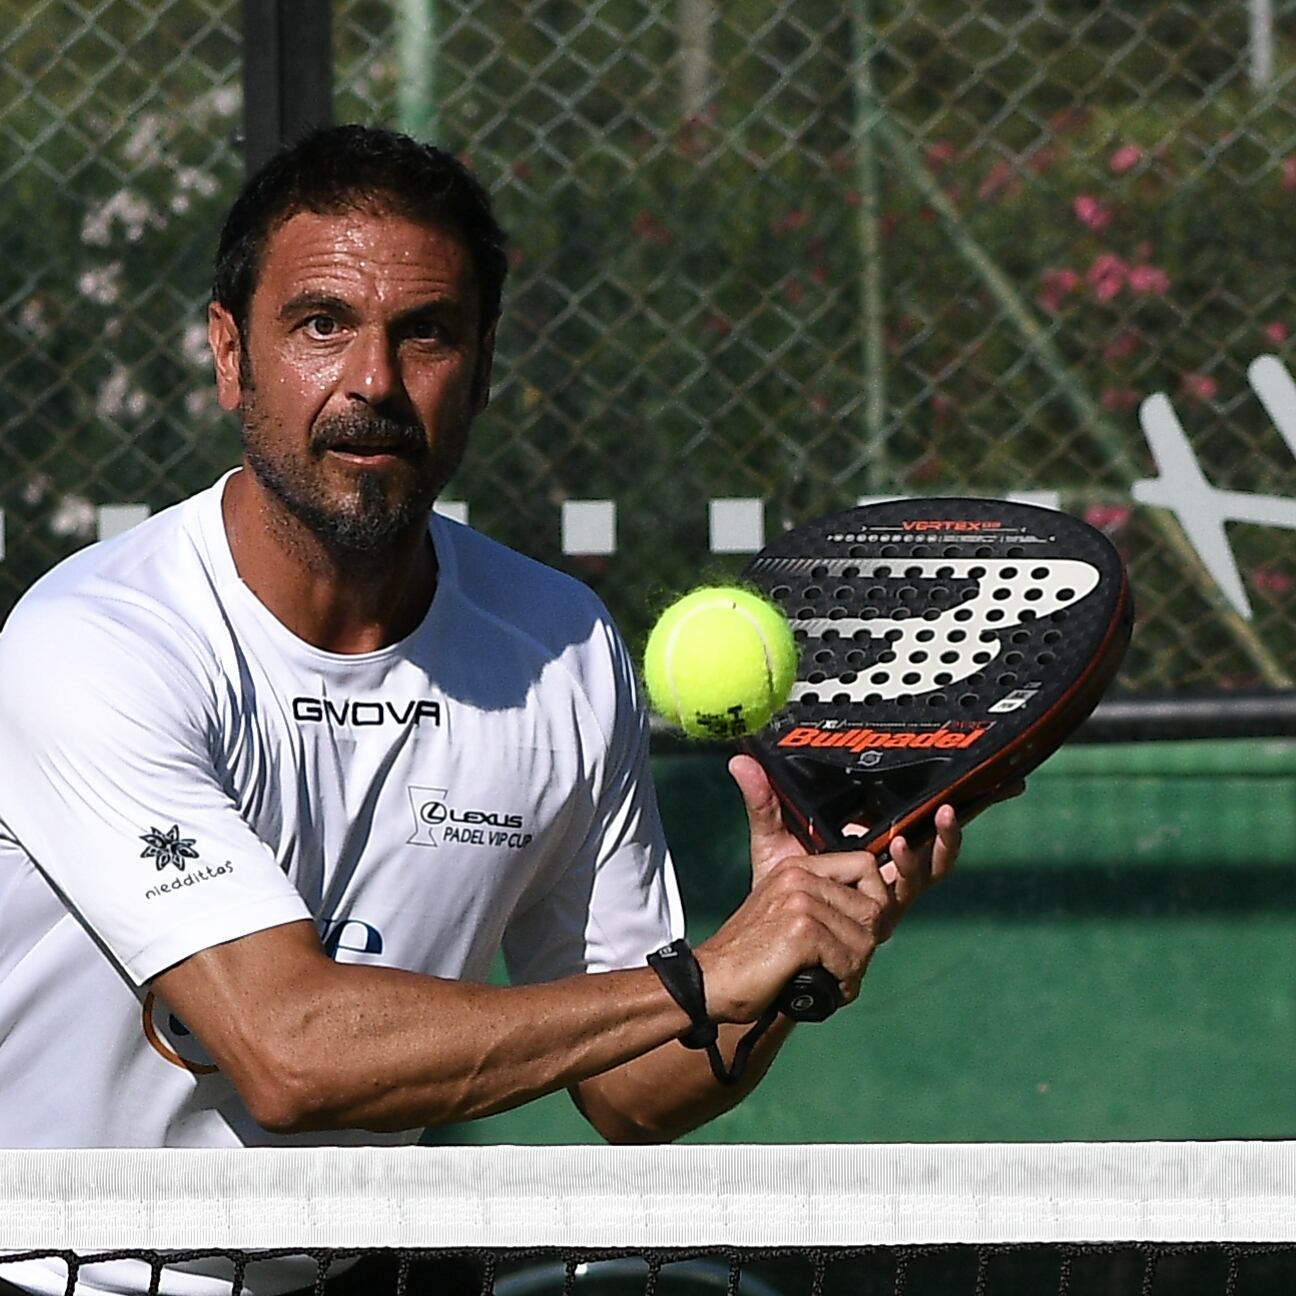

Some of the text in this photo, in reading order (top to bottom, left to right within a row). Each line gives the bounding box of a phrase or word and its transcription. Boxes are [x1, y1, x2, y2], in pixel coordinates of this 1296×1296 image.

[777, 727, 987, 753] Bullpadel
[449, 809, 523, 829] LEXUS
[443, 826, 533, 848] PADEL VIP CUP
[145, 860, 234, 900] nieddittas
